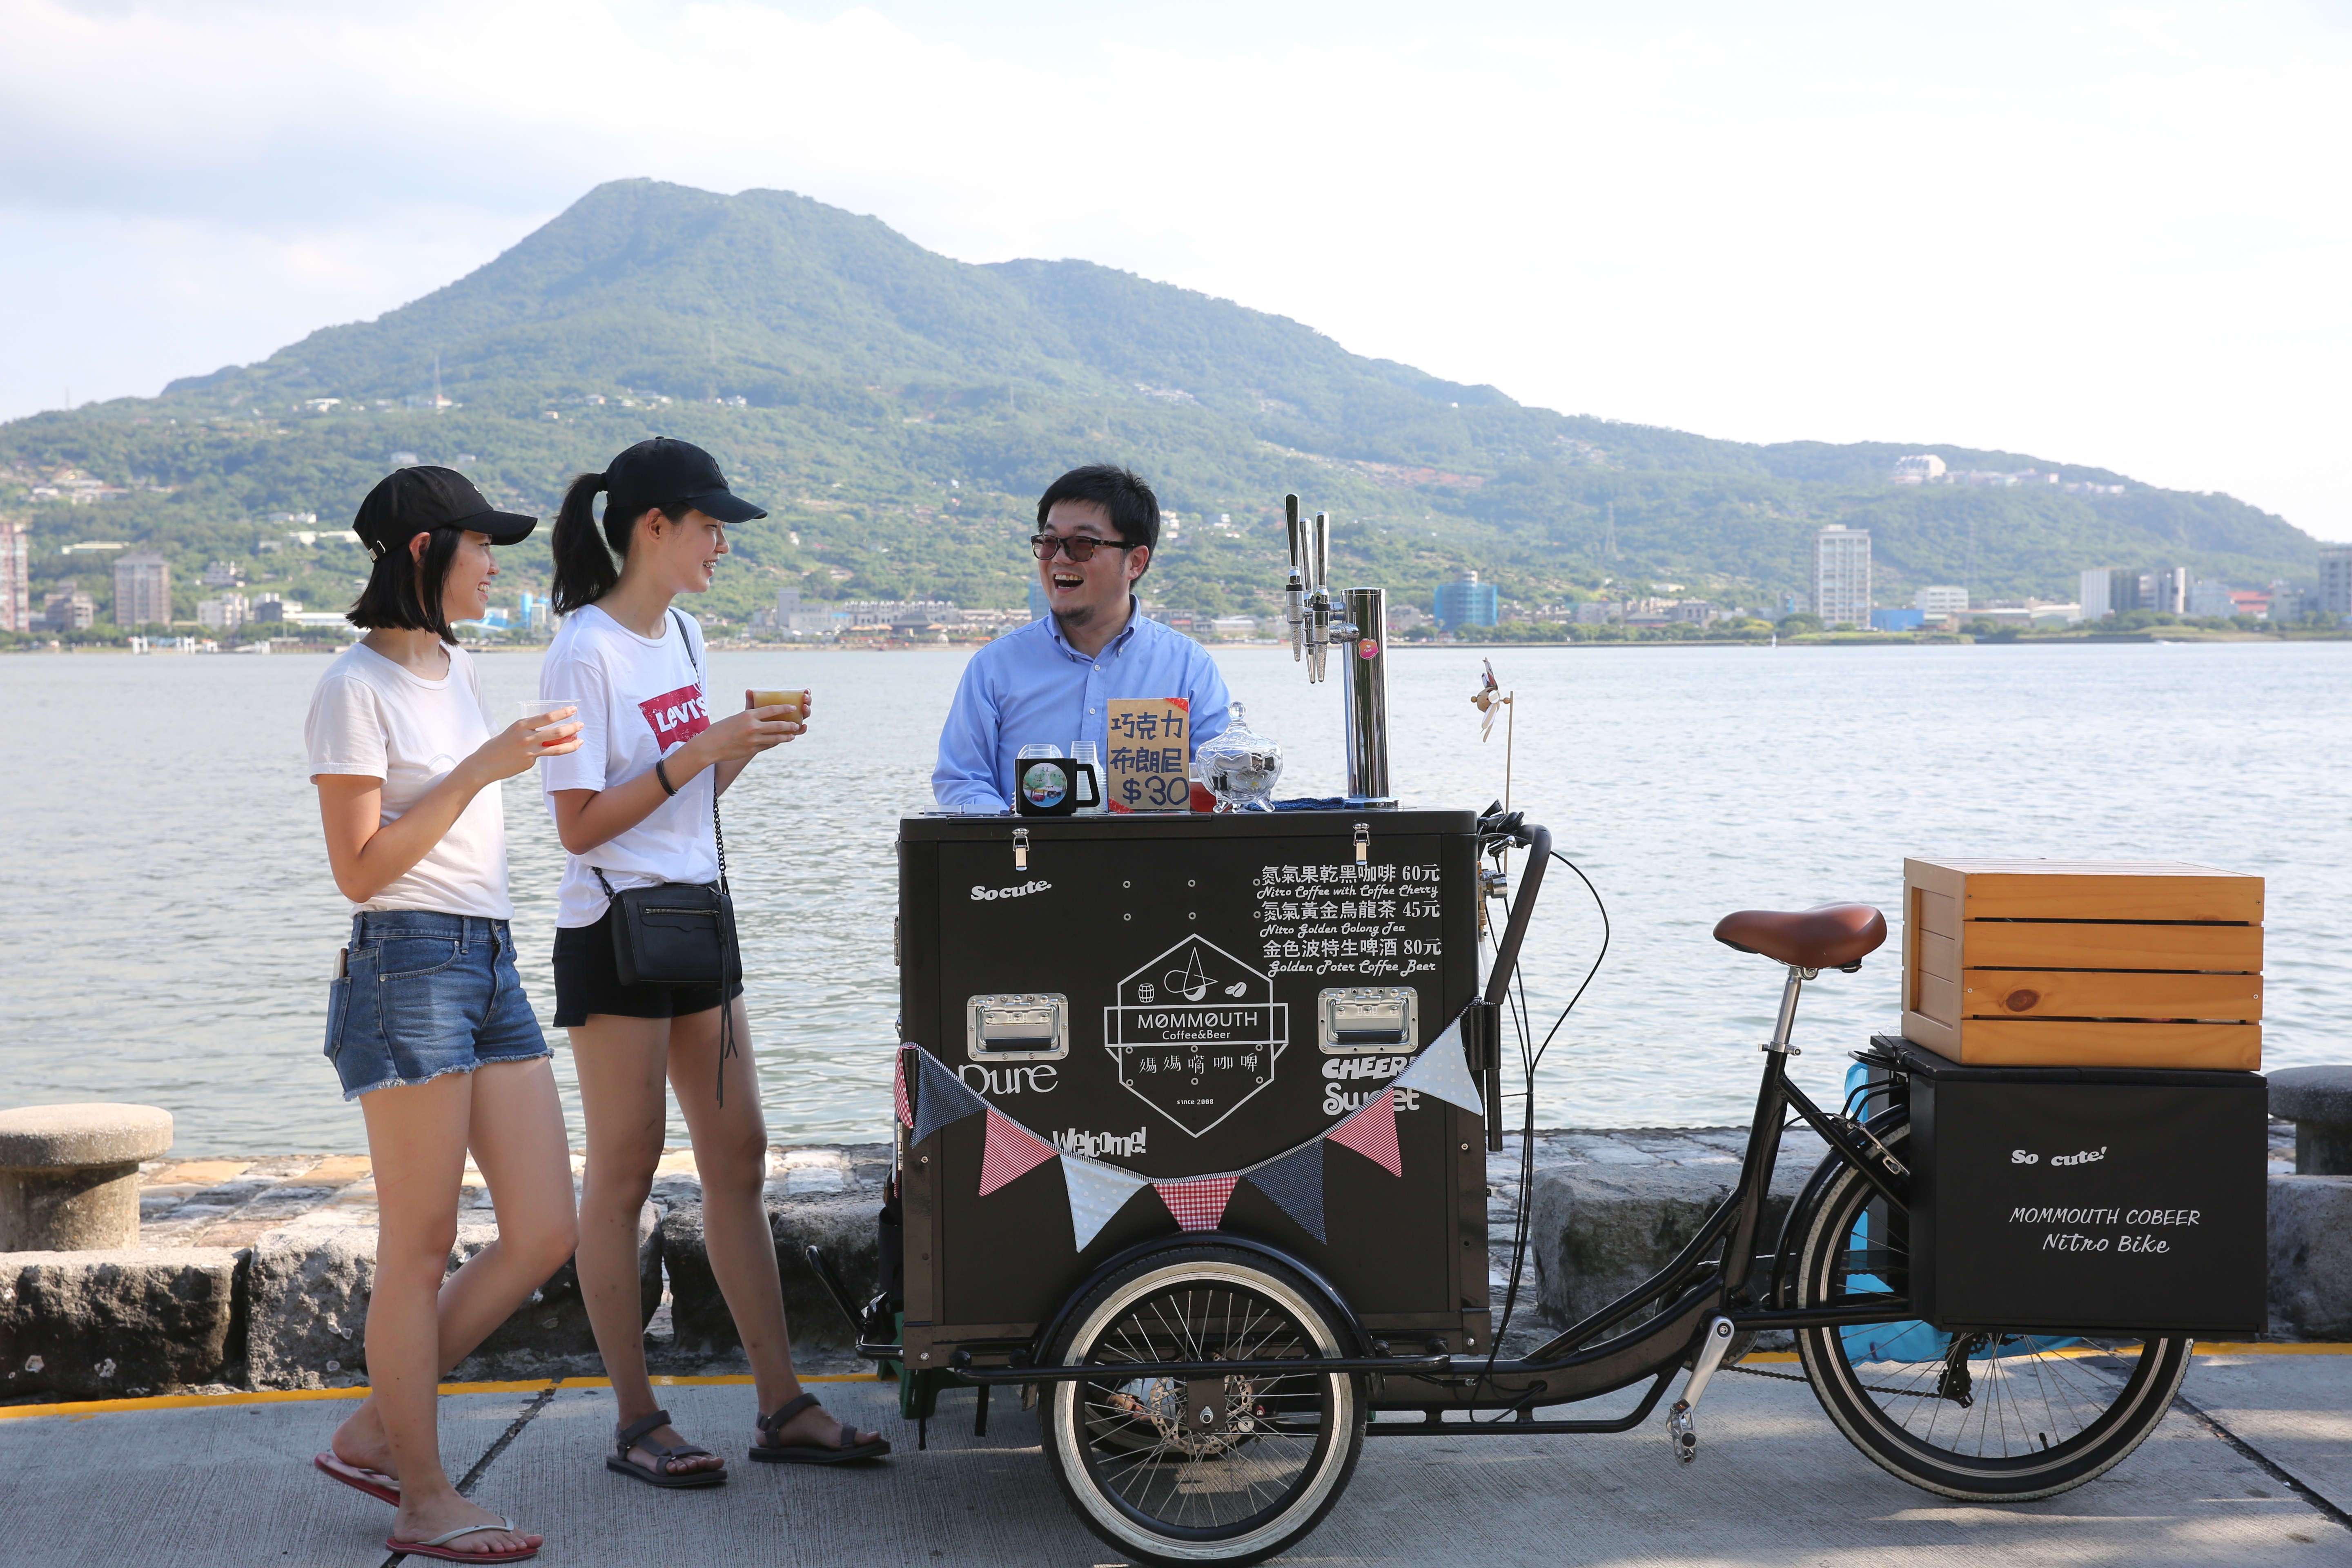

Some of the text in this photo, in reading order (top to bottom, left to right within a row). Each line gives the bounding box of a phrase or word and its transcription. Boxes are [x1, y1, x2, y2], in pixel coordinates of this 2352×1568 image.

[1110, 710, 1183, 740] 巧克力
[1109, 746, 1182, 774] 布朗尼
[1122, 775, 1189, 806] $30
[1262, 864, 1440, 886] 氮氣果乾黑咖啡 60元
[1256, 884, 1439, 900] Nitro Coffee with Coffee Cherry
[1261, 899, 1440, 922] 氮氣黃金烏龍茶 45元
[1259, 922, 1405, 939] Nitro Golden Oolong Tea
[1263, 938, 1442, 958] 金色波特生啤酒 80元
[1267, 959, 1436, 977] Golden Poter Coffee Beer
[1162, 1029, 1231, 1040] Coffee&Beer
[1139, 1053, 1258, 1074] 媽媽嘴咖啤
[1321, 1056, 1417, 1079] CHEER
[1052, 1126, 1146, 1158] Welcome!
[2011, 1146, 2107, 1166] So cute!
[2009, 1207, 2200, 1226] MOMMOUTH COBEER
[2042, 1233, 2170, 1253] Nitro Bike
